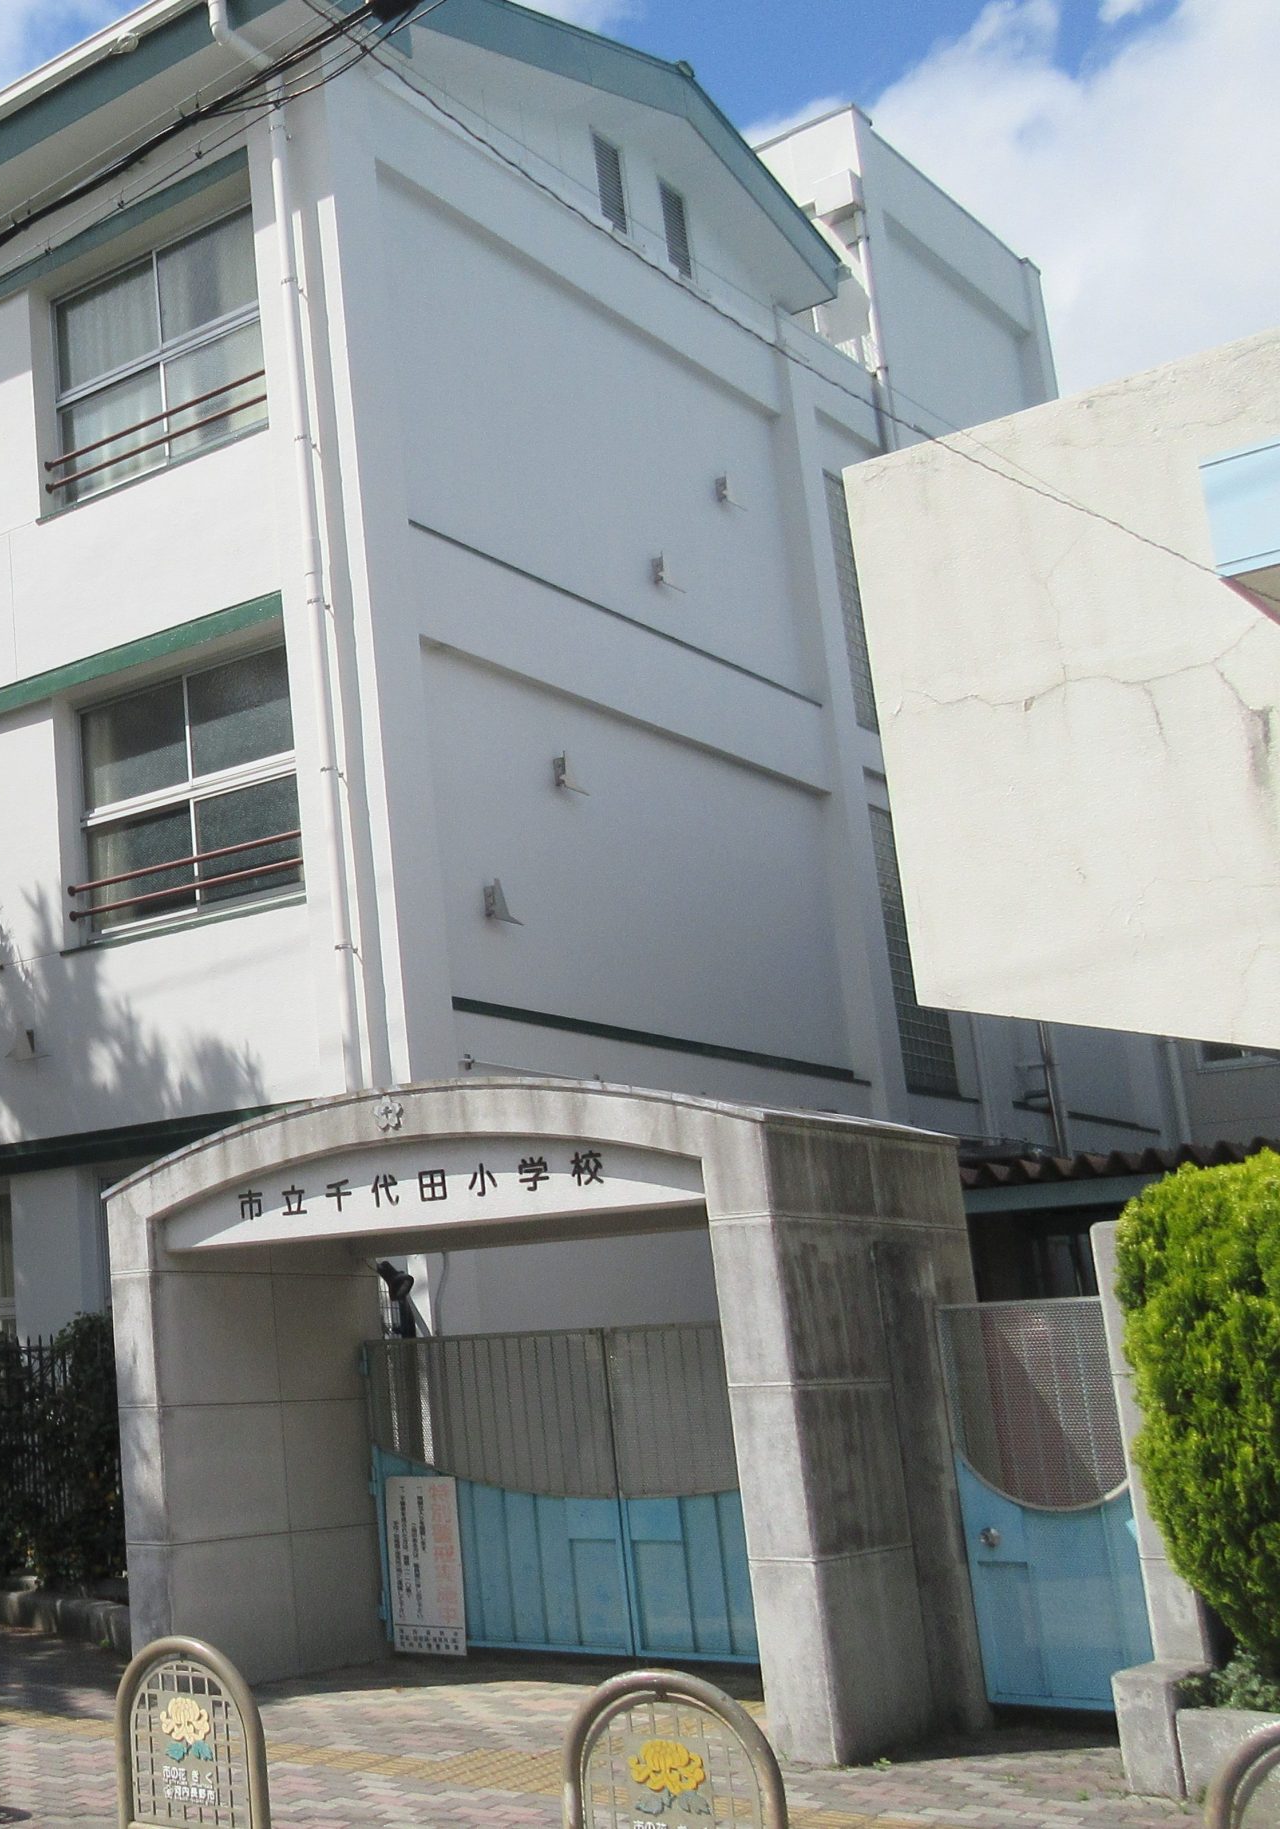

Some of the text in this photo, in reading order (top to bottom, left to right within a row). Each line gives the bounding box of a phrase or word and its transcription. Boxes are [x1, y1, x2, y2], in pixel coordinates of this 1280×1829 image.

[238, 1150, 604, 1220] 市立千代田小学校
[163, 1766, 186, 1782] 市の花
[174, 1785, 216, 1805] 河内長野市
